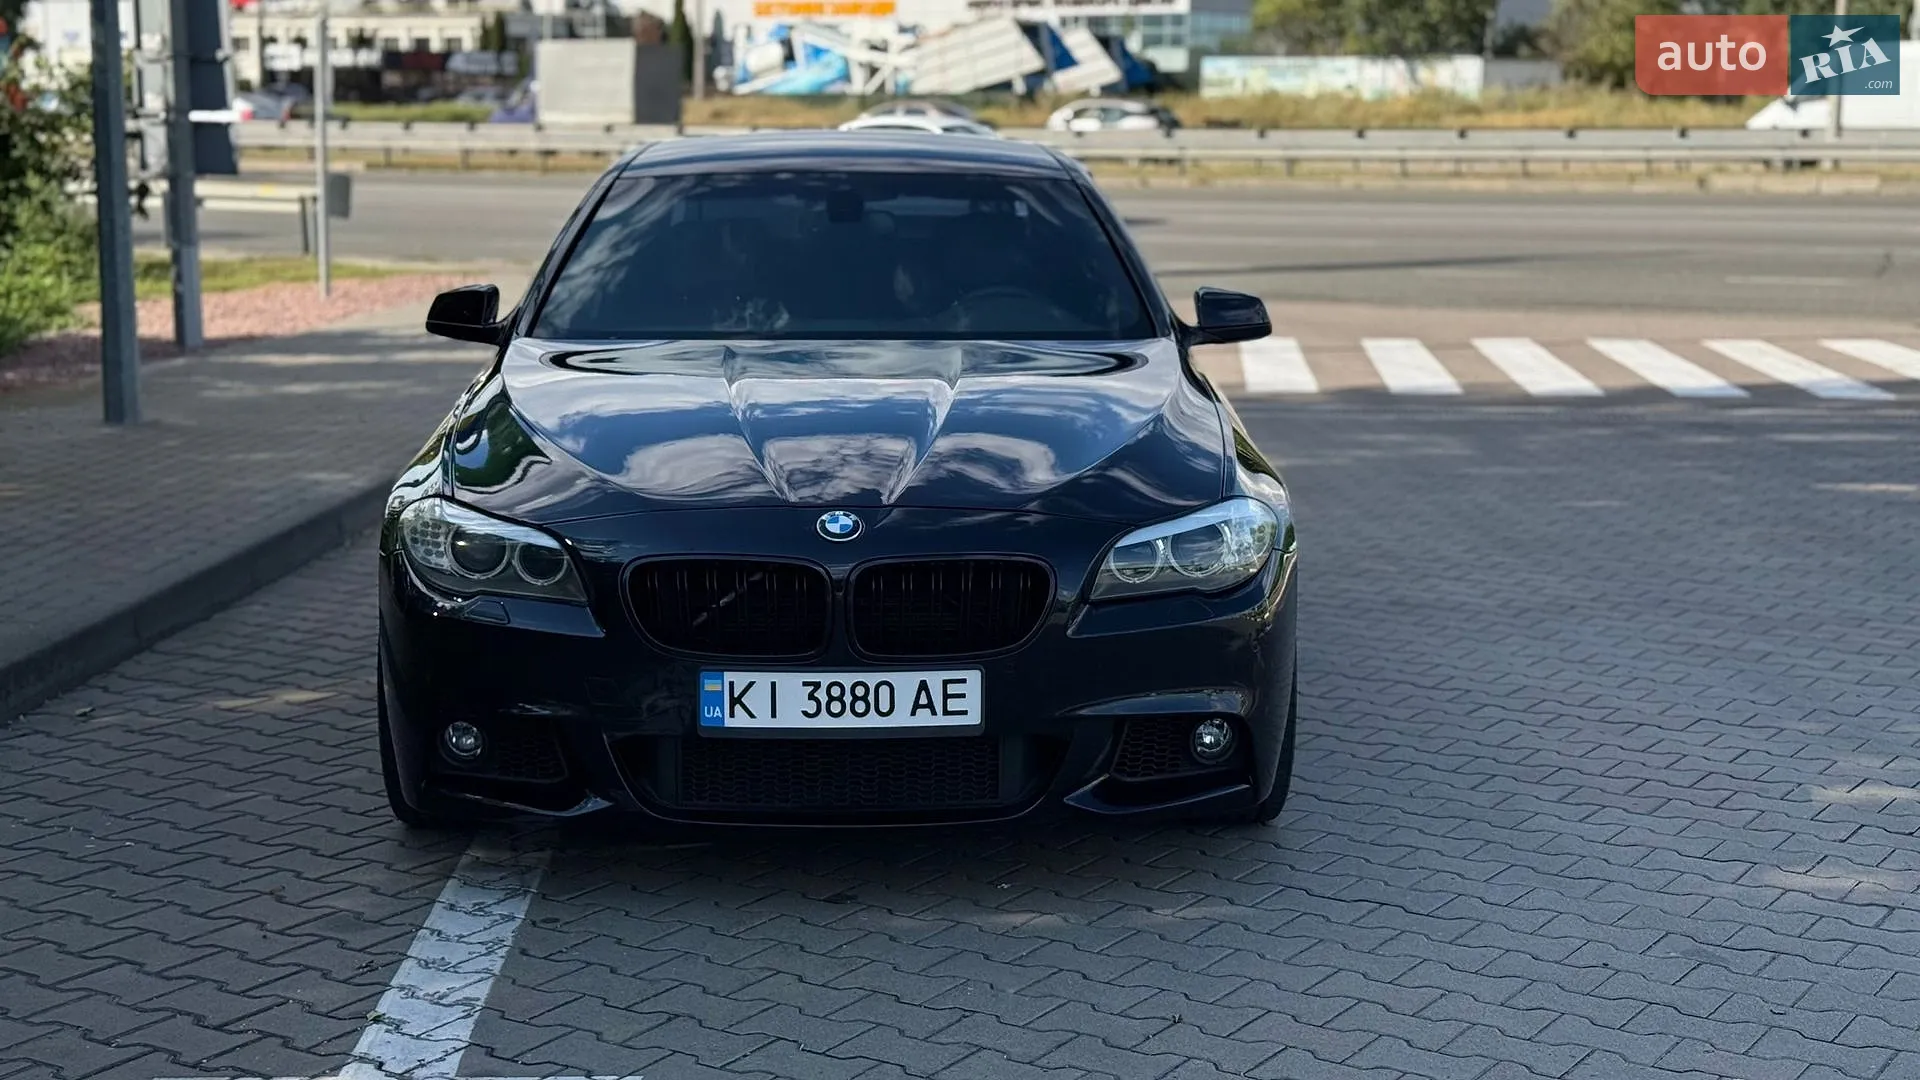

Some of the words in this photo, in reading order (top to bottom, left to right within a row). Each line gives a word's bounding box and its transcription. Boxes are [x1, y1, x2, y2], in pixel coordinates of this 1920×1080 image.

[728, 680, 777, 719] KI
[801, 680, 895, 718] 3880
[910, 678, 969, 716] AE
[704, 706, 722, 718] UA
